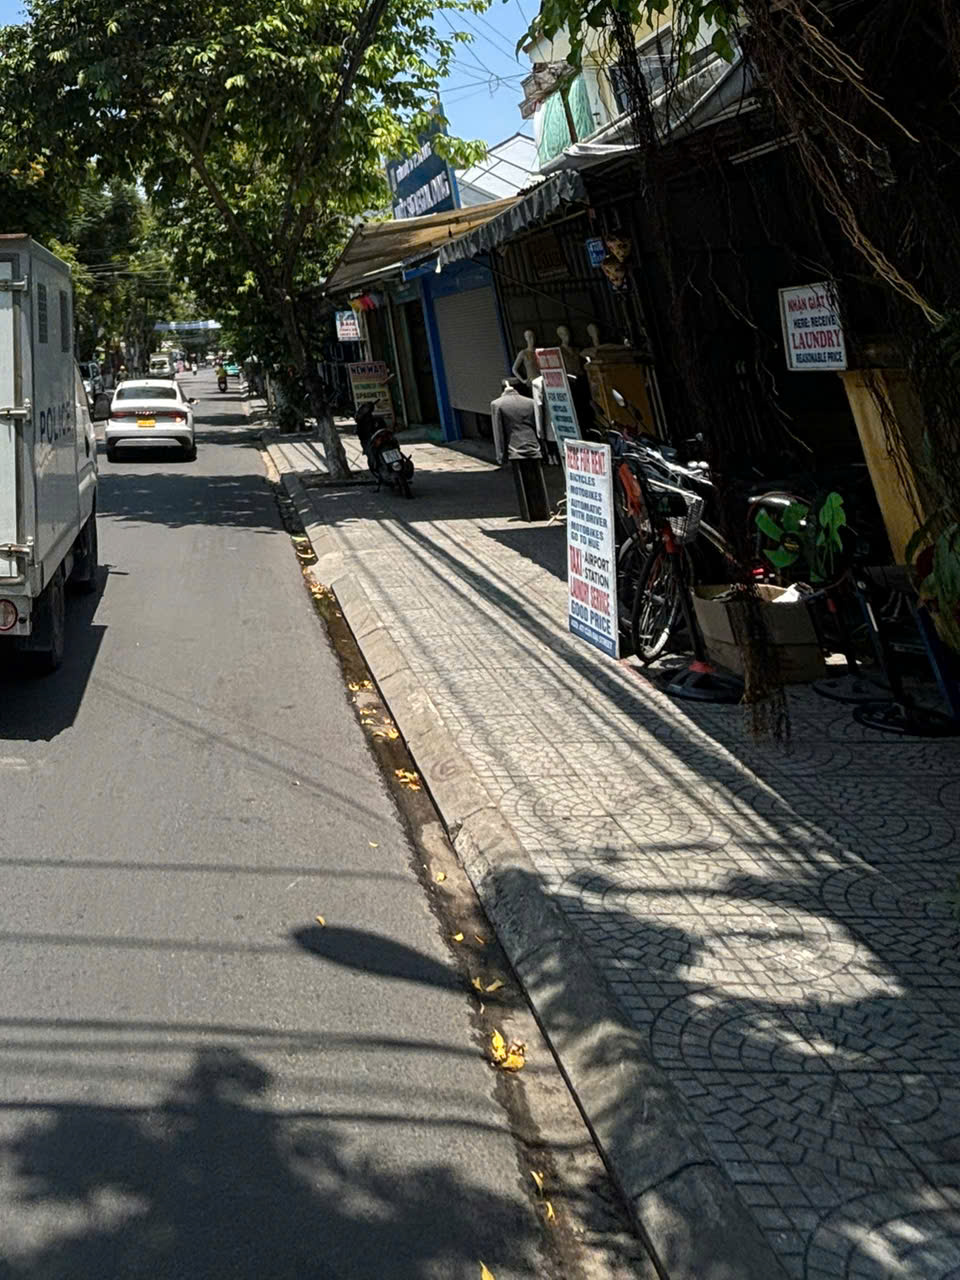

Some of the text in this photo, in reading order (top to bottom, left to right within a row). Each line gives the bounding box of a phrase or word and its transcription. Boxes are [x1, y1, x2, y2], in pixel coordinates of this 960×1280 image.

[792, 329, 841, 350] LAUNDRY
[796, 351, 843, 364] REASONABLE PRICE
[567, 446, 605, 476] HERE FOR RENT
[569, 472, 596, 487] BICYCLES
[571, 498, 602, 516] AUTOMATIC
[571, 508, 608, 528] WITH DRIVER
[571, 531, 579, 542] GO
[580, 534, 587, 545] TO
[569, 543, 610, 576] TAXI AIRPORT
[584, 567, 610, 590] STATION
[590, 584, 611, 617] SERVICE
[571, 599, 589, 622] GOOD
[590, 609, 612, 635] PRICE
